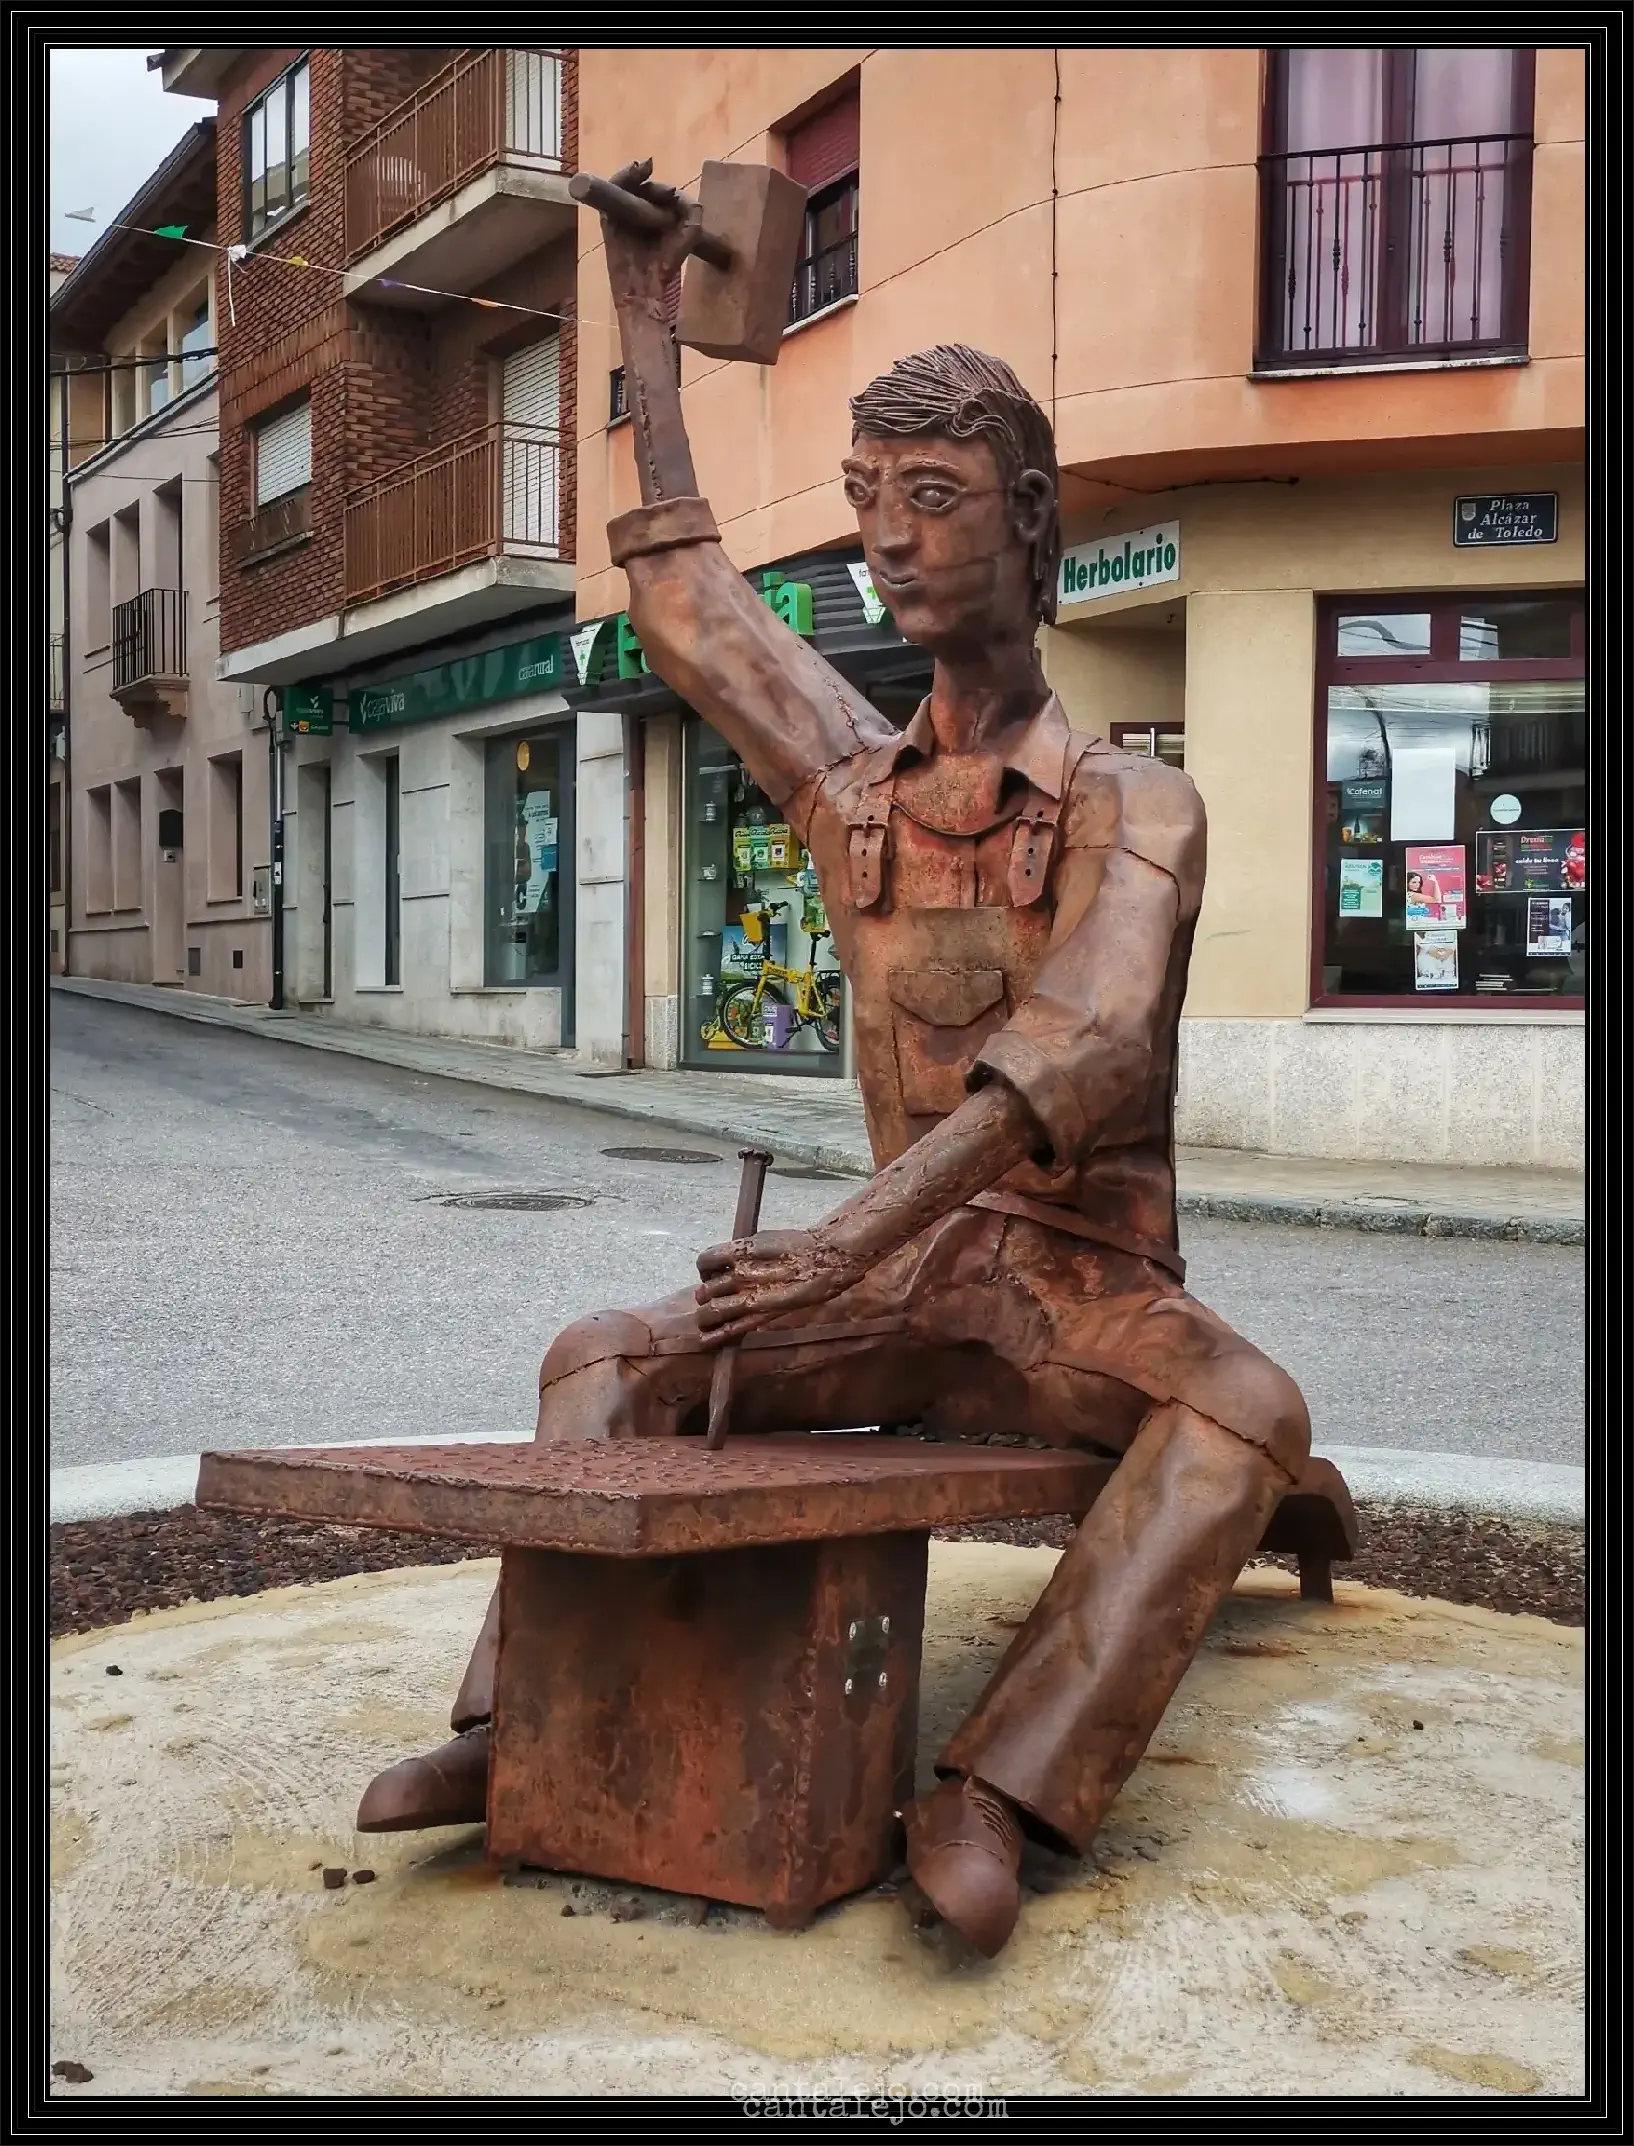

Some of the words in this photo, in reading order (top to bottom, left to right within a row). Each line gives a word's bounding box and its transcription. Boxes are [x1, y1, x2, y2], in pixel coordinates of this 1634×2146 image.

[1489, 499, 1530, 511] Plaza
[1480, 511, 1537, 526] Alcázar
[1467, 528, 1484, 540] de
[1496, 525, 1543, 539] Toledo
[1063, 532, 1176, 594] Herbolario
